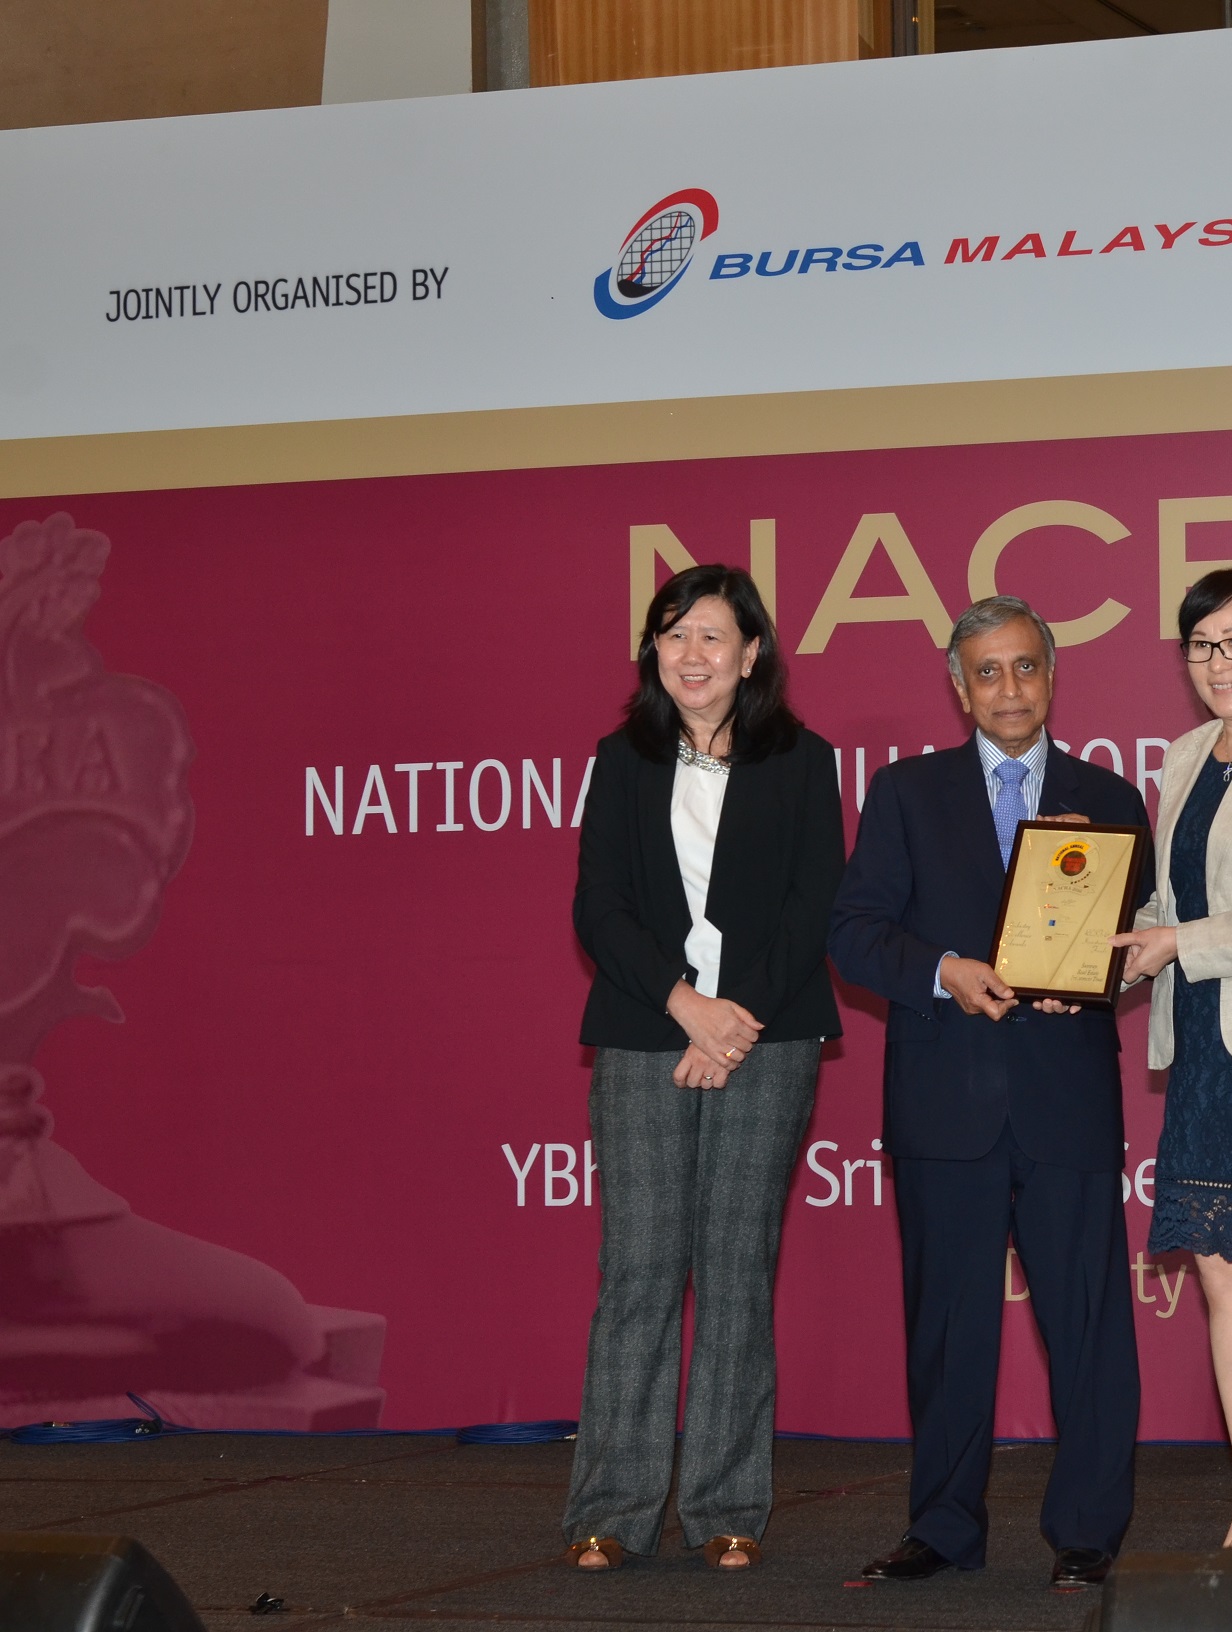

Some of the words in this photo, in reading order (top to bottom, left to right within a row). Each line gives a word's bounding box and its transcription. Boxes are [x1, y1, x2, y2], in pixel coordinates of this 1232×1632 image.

[709, 241, 926, 282] BURSA
[105, 283, 223, 324] JOINTLY
[232, 271, 399, 316] ORGANISED
[411, 266, 450, 302] BY
[304, 757, 596, 836] NATION
[804, 1138, 884, 1208] Sri
